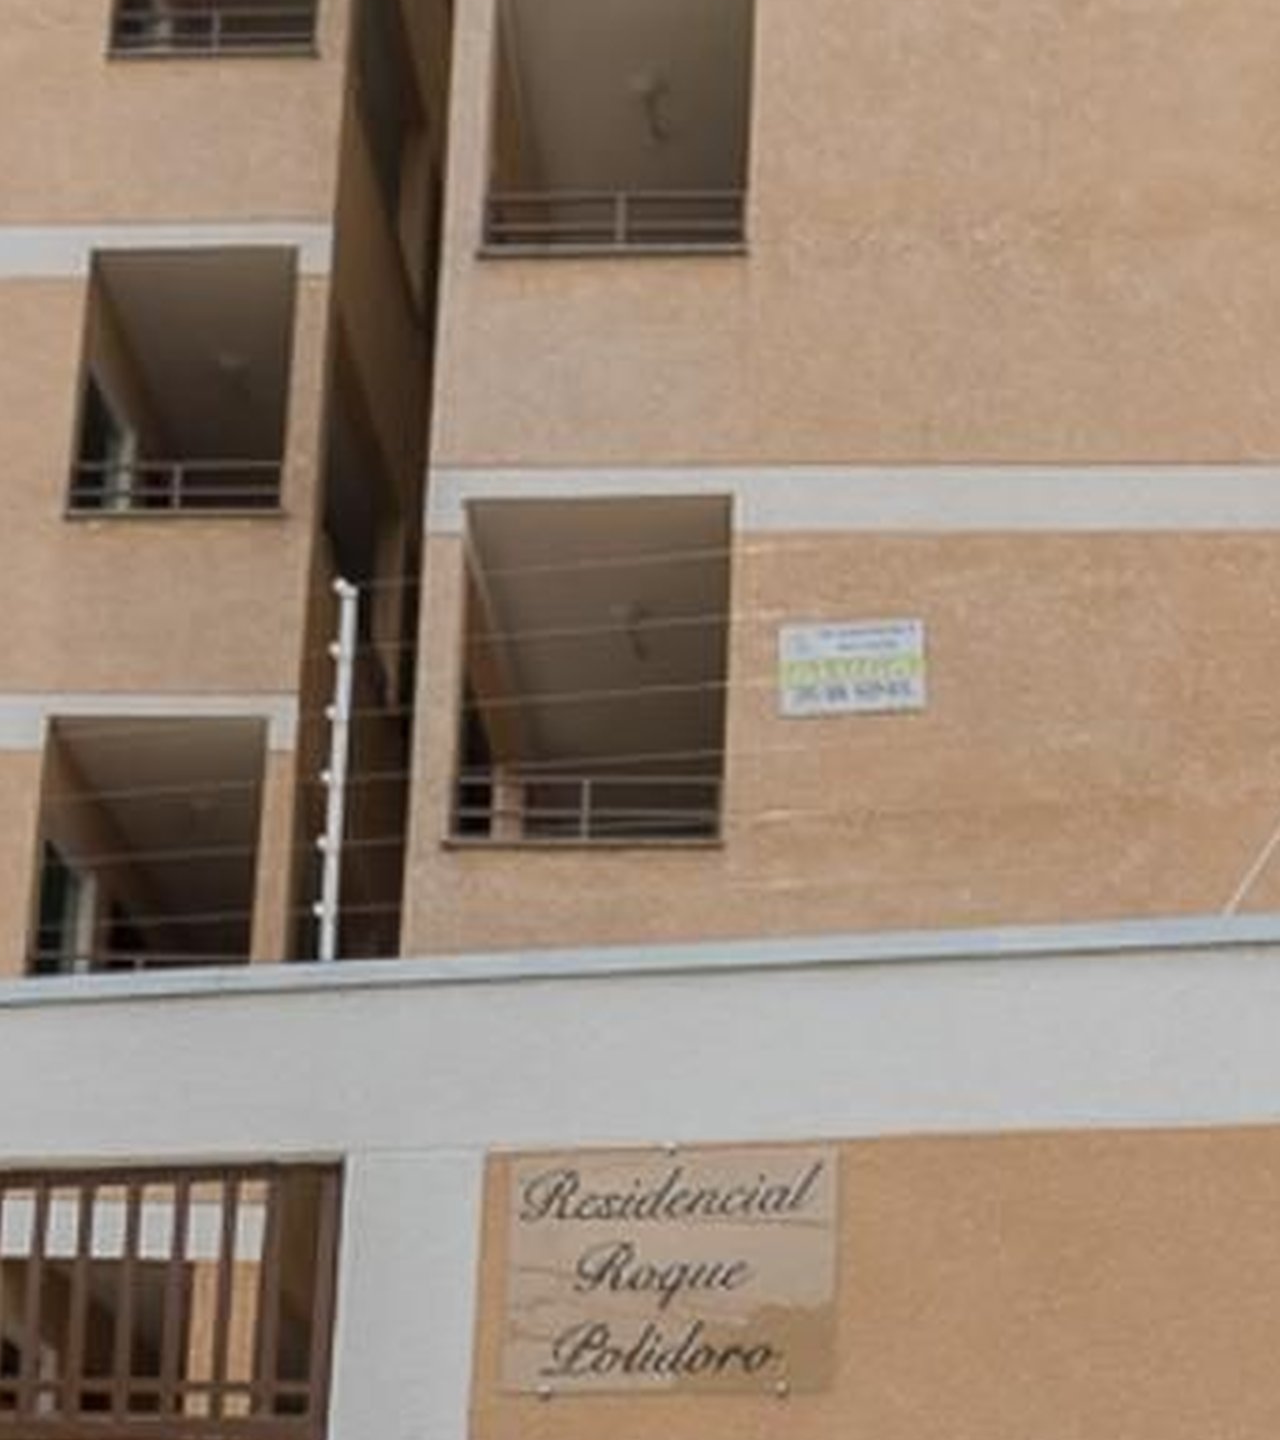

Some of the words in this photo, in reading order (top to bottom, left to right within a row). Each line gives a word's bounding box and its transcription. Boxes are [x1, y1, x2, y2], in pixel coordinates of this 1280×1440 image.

[519, 1160, 823, 1223] Residencial
[573, 1240, 753, 1311] Roque
[540, 1320, 778, 1377] Polidoro
